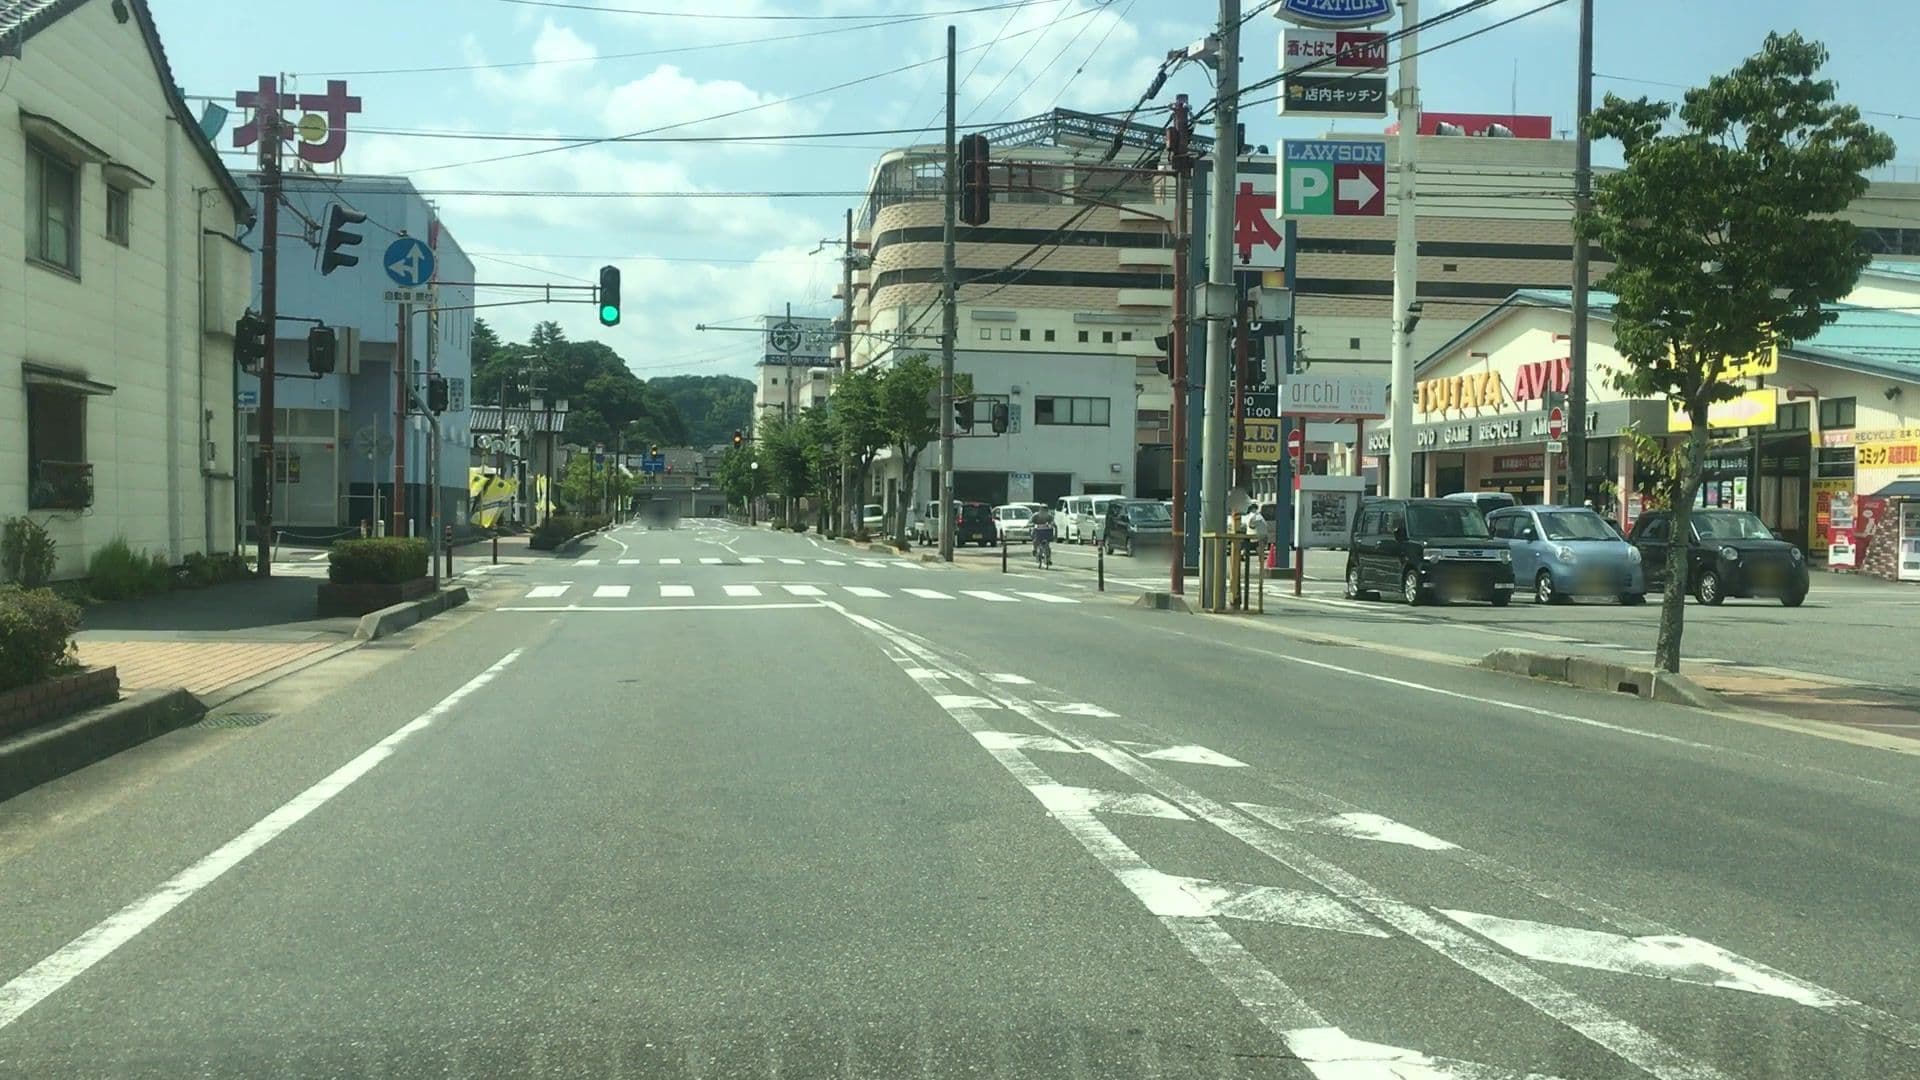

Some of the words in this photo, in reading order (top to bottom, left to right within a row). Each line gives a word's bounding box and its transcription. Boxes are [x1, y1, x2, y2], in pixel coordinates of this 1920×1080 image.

[1340, 41, 1385, 59] ATM
[1305, 88, 1383, 102] 店内キッチン
[1287, 143, 1383, 162] LAWSON
[1289, 167, 1329, 210] P
[1233, 182, 1283, 259] 本
[1291, 380, 1341, 404] archi
[1417, 370, 1503, 414] TSUTAYA
[1417, 429, 1437, 446] DVD
[1443, 425, 1471, 444] GAME
[1478, 418, 1519, 441] RECYCLE
[1855, 430, 1896, 441] RECYCLE
[1859, 447, 1887, 465] コミック
